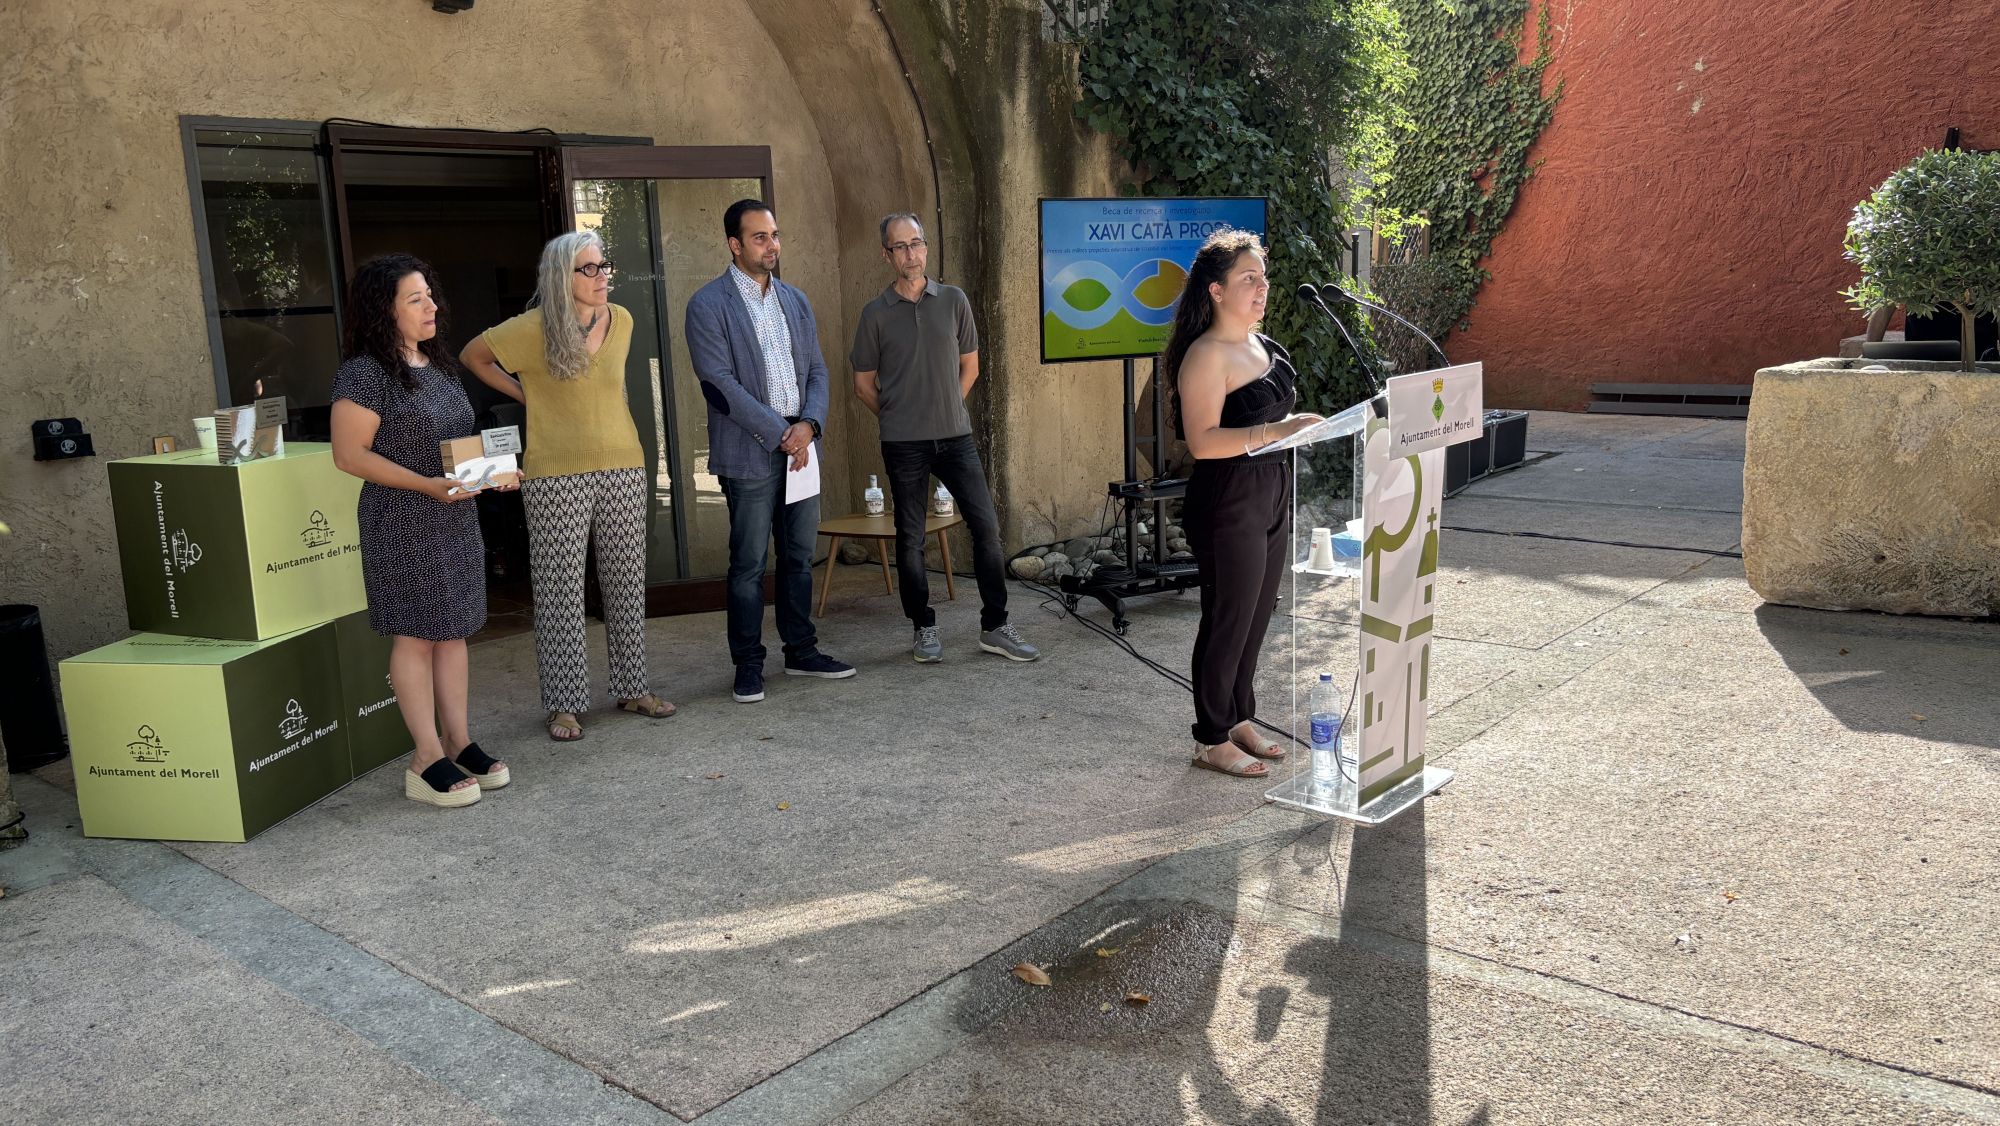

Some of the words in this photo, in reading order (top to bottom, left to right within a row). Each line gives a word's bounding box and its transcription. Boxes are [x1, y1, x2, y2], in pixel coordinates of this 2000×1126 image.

[1102, 206, 1121, 215] Beca
[1123, 206, 1133, 215] de
[1088, 223, 1125, 240] XAVI
[1131, 219, 1173, 239] CATÀ
[1401, 428, 1441, 446] Ajuntament
[1442, 422, 1453, 434] del
[1454, 417, 1474, 432] Morell
[154, 480, 169, 555] Ajuntament
[164, 558, 173, 576] del
[266, 552, 325, 573] Ajuntament
[327, 546, 341, 557] del
[343, 543, 361, 553] Mor
[167, 580, 179, 618] Morell
[358, 695, 397, 717] Ajuntame
[249, 741, 300, 773] Ajuntament
[301, 732, 314, 746] del
[314, 719, 338, 739] Morell
[89, 765, 156, 778] Ajuntament
[160, 768, 177, 778] del
[181, 768, 220, 778] Morell
